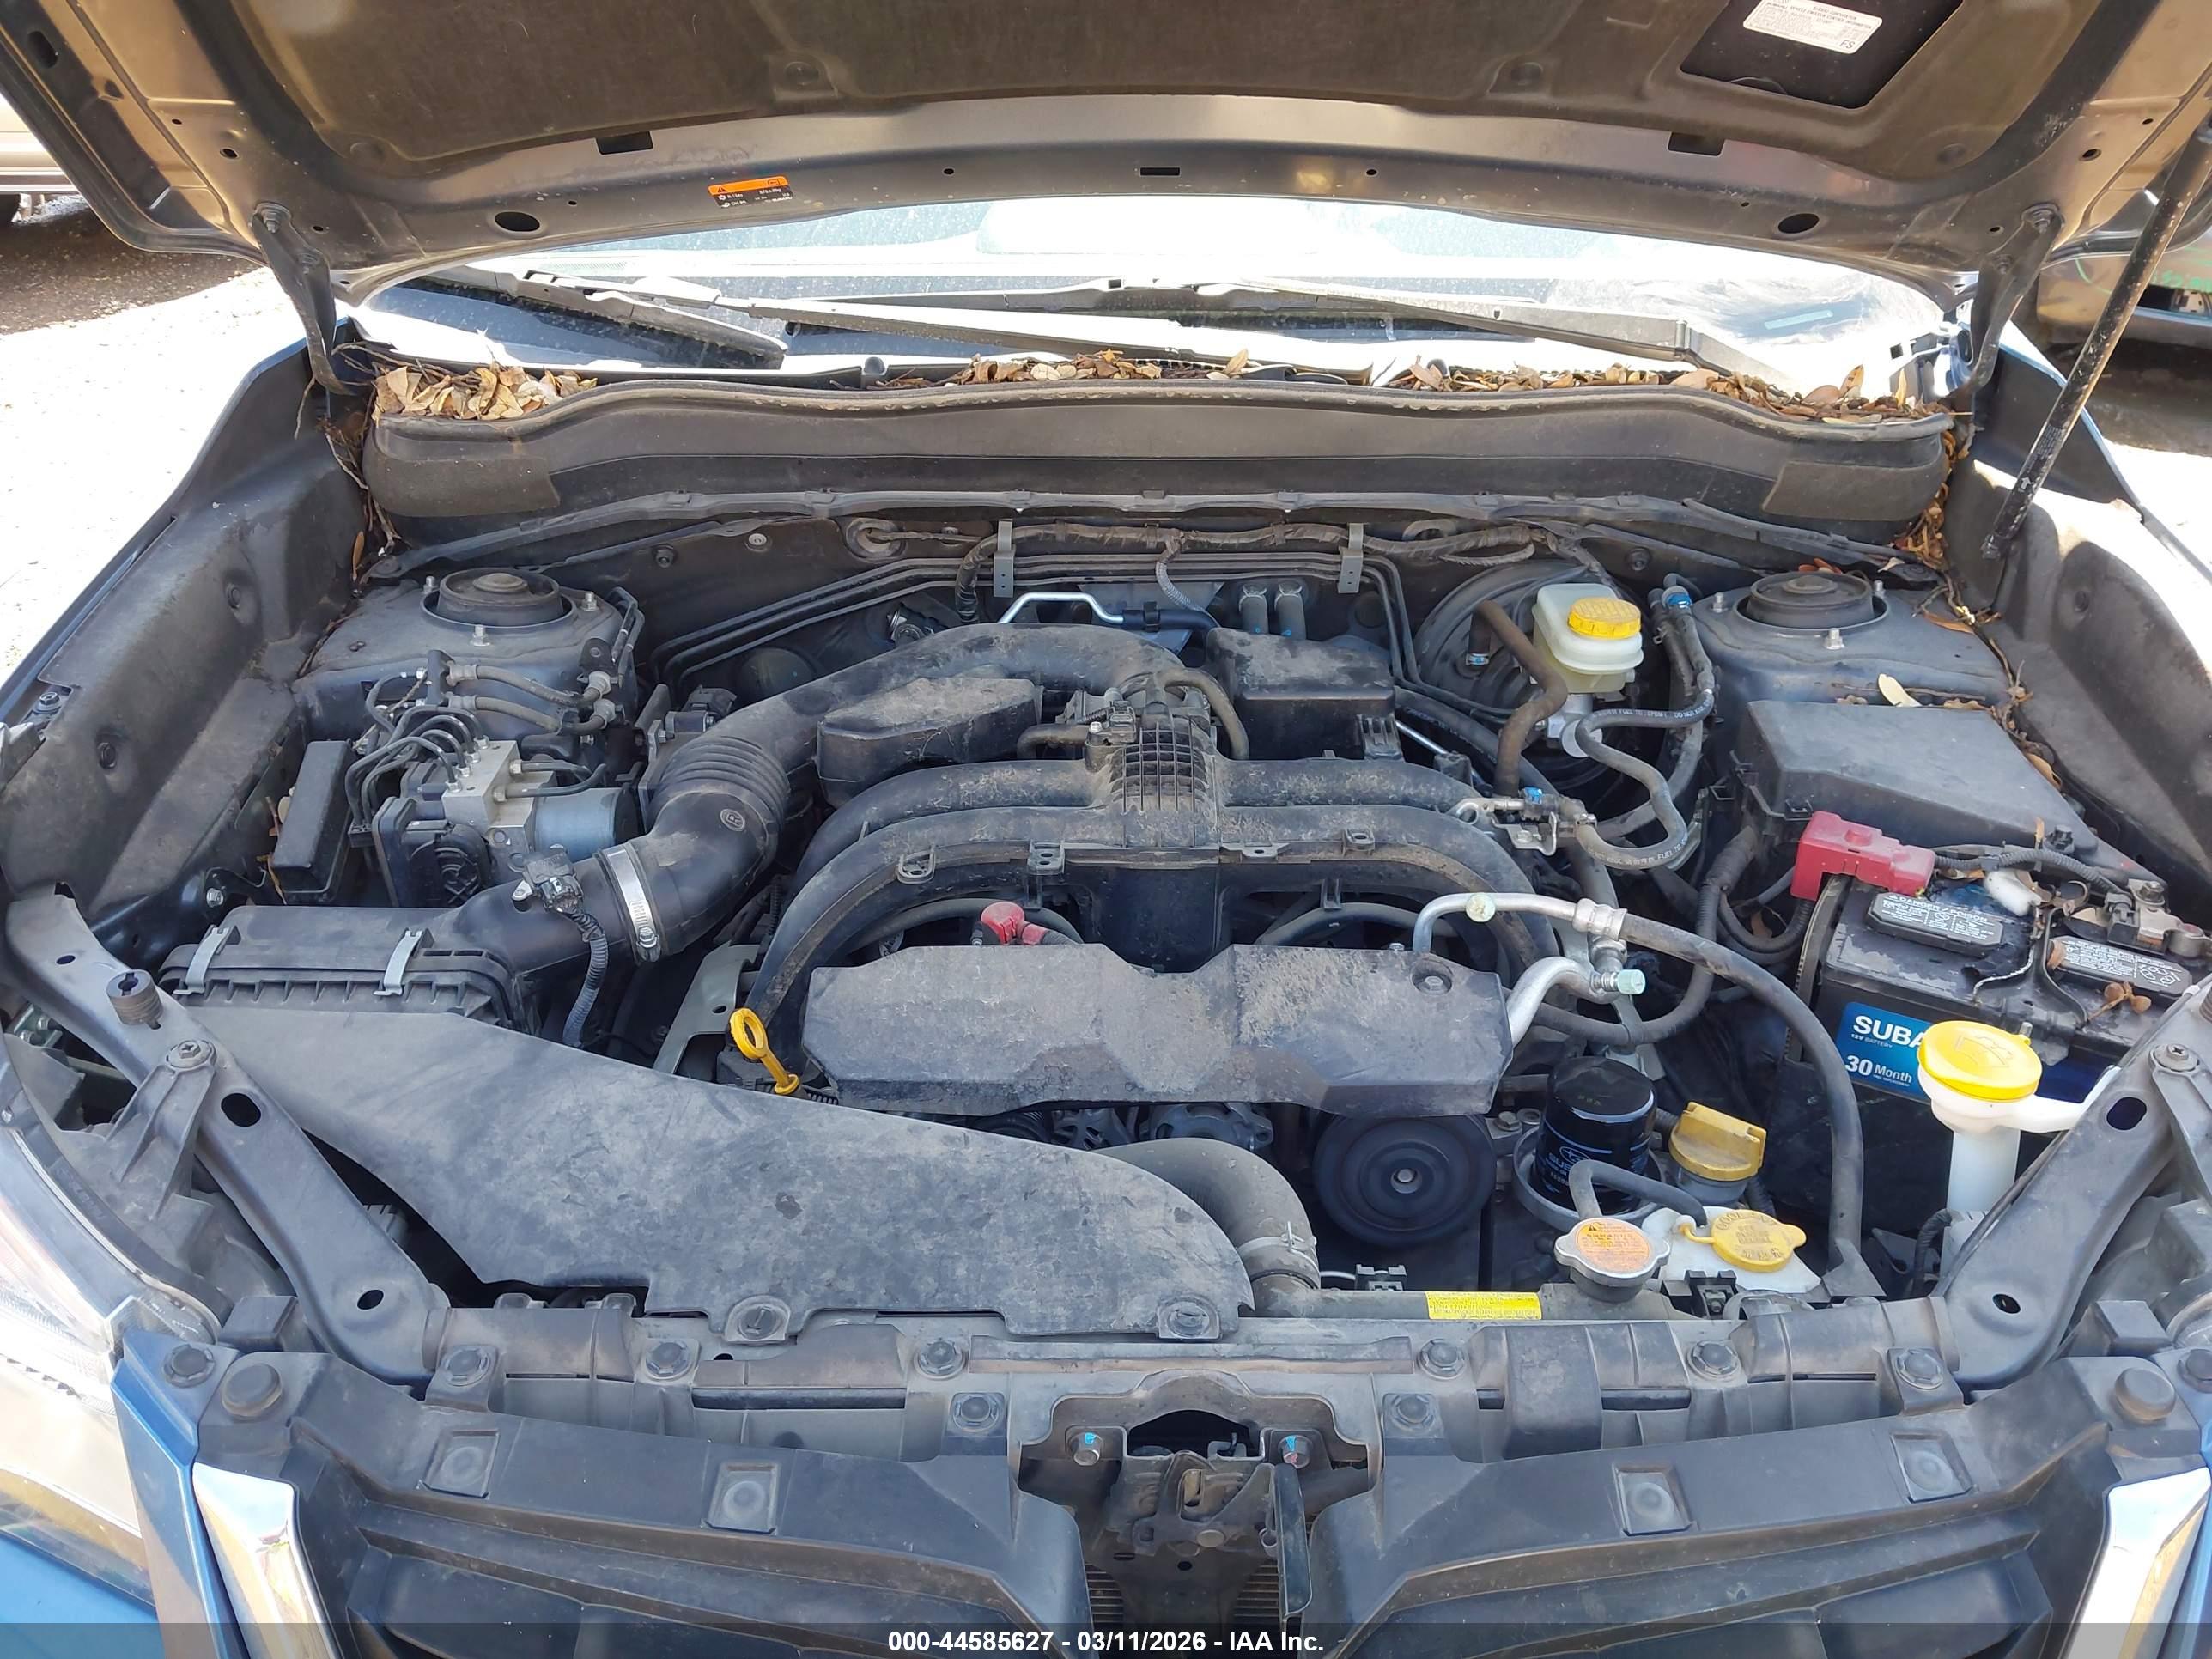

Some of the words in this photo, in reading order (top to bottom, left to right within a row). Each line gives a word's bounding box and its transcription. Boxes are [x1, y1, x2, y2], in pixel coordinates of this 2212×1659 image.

[1839, 39, 1856, 49] FS
[1899, 896, 1941, 912] DANGER
[1950, 909, 1988, 922] POISON
[1845, 1055, 1873, 1076] 30
[1875, 1064, 1912, 1084] Month
